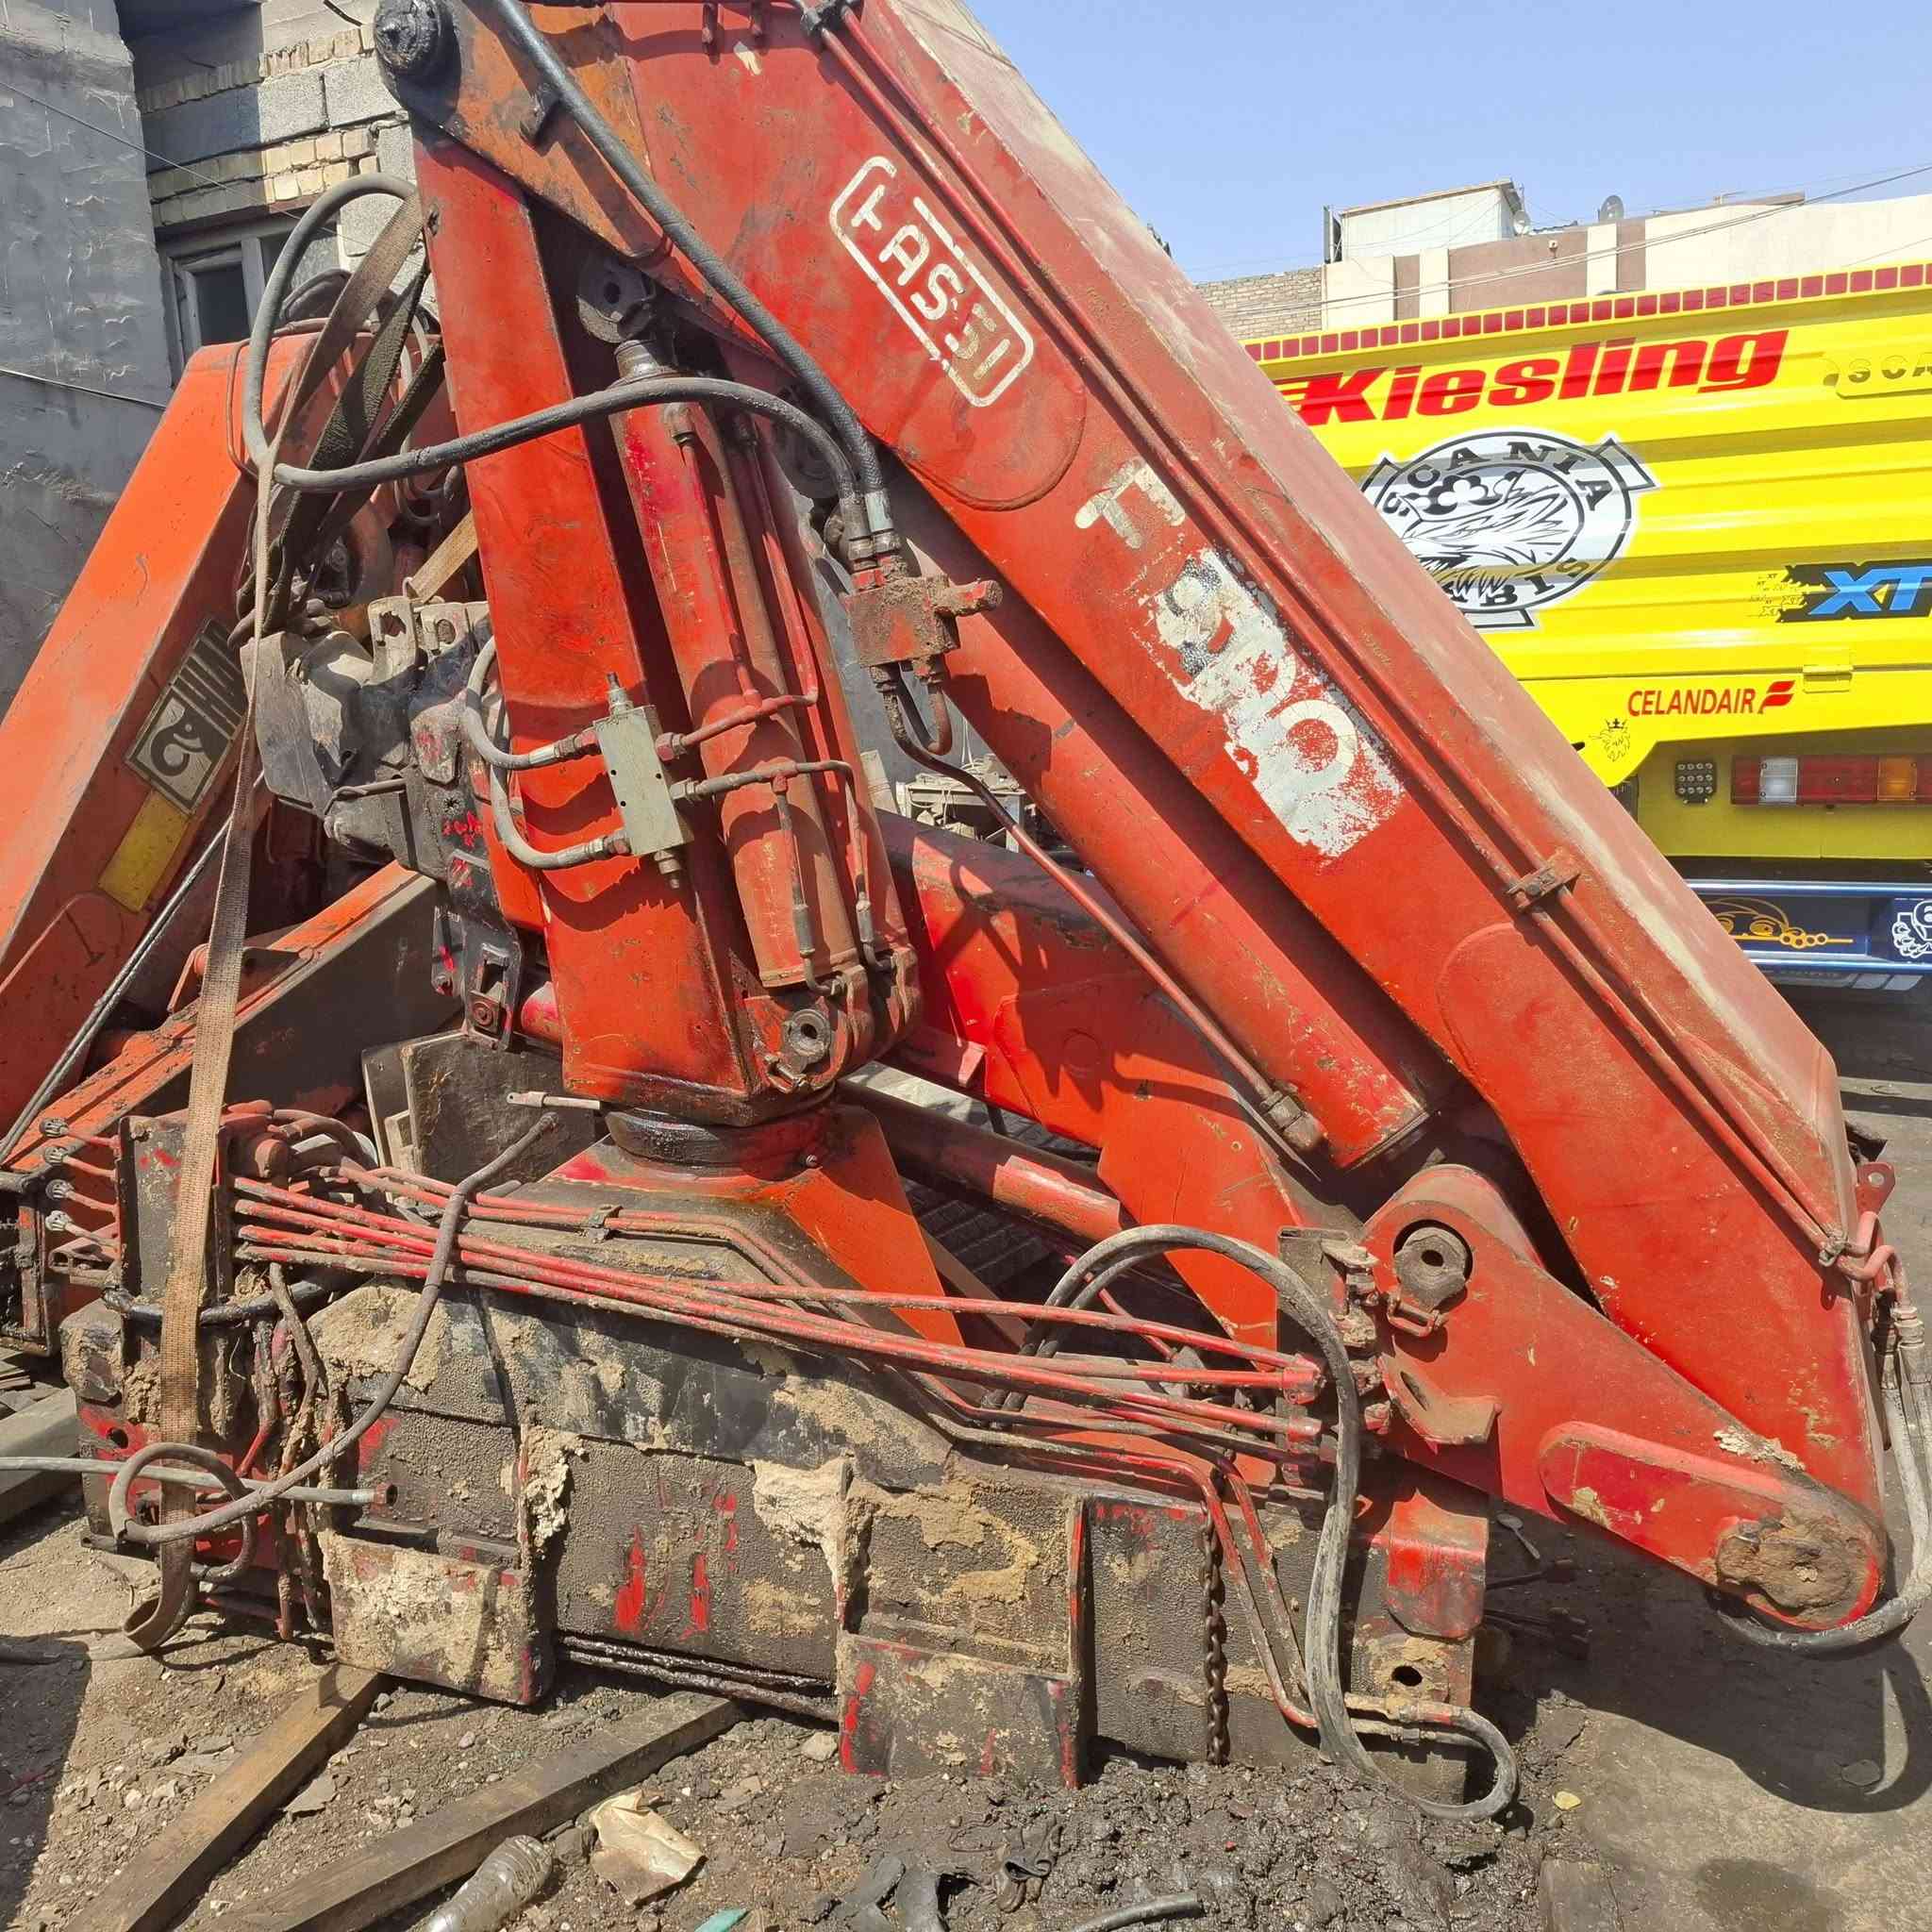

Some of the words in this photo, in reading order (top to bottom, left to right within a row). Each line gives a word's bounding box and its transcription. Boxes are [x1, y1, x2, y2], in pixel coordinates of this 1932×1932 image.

[1298, 330, 1790, 427] Kiesling
[1382, 441, 1613, 517] SCANIA
[1441, 557, 1590, 607] ABIS
[1627, 688, 1757, 717] CELANDAIR
